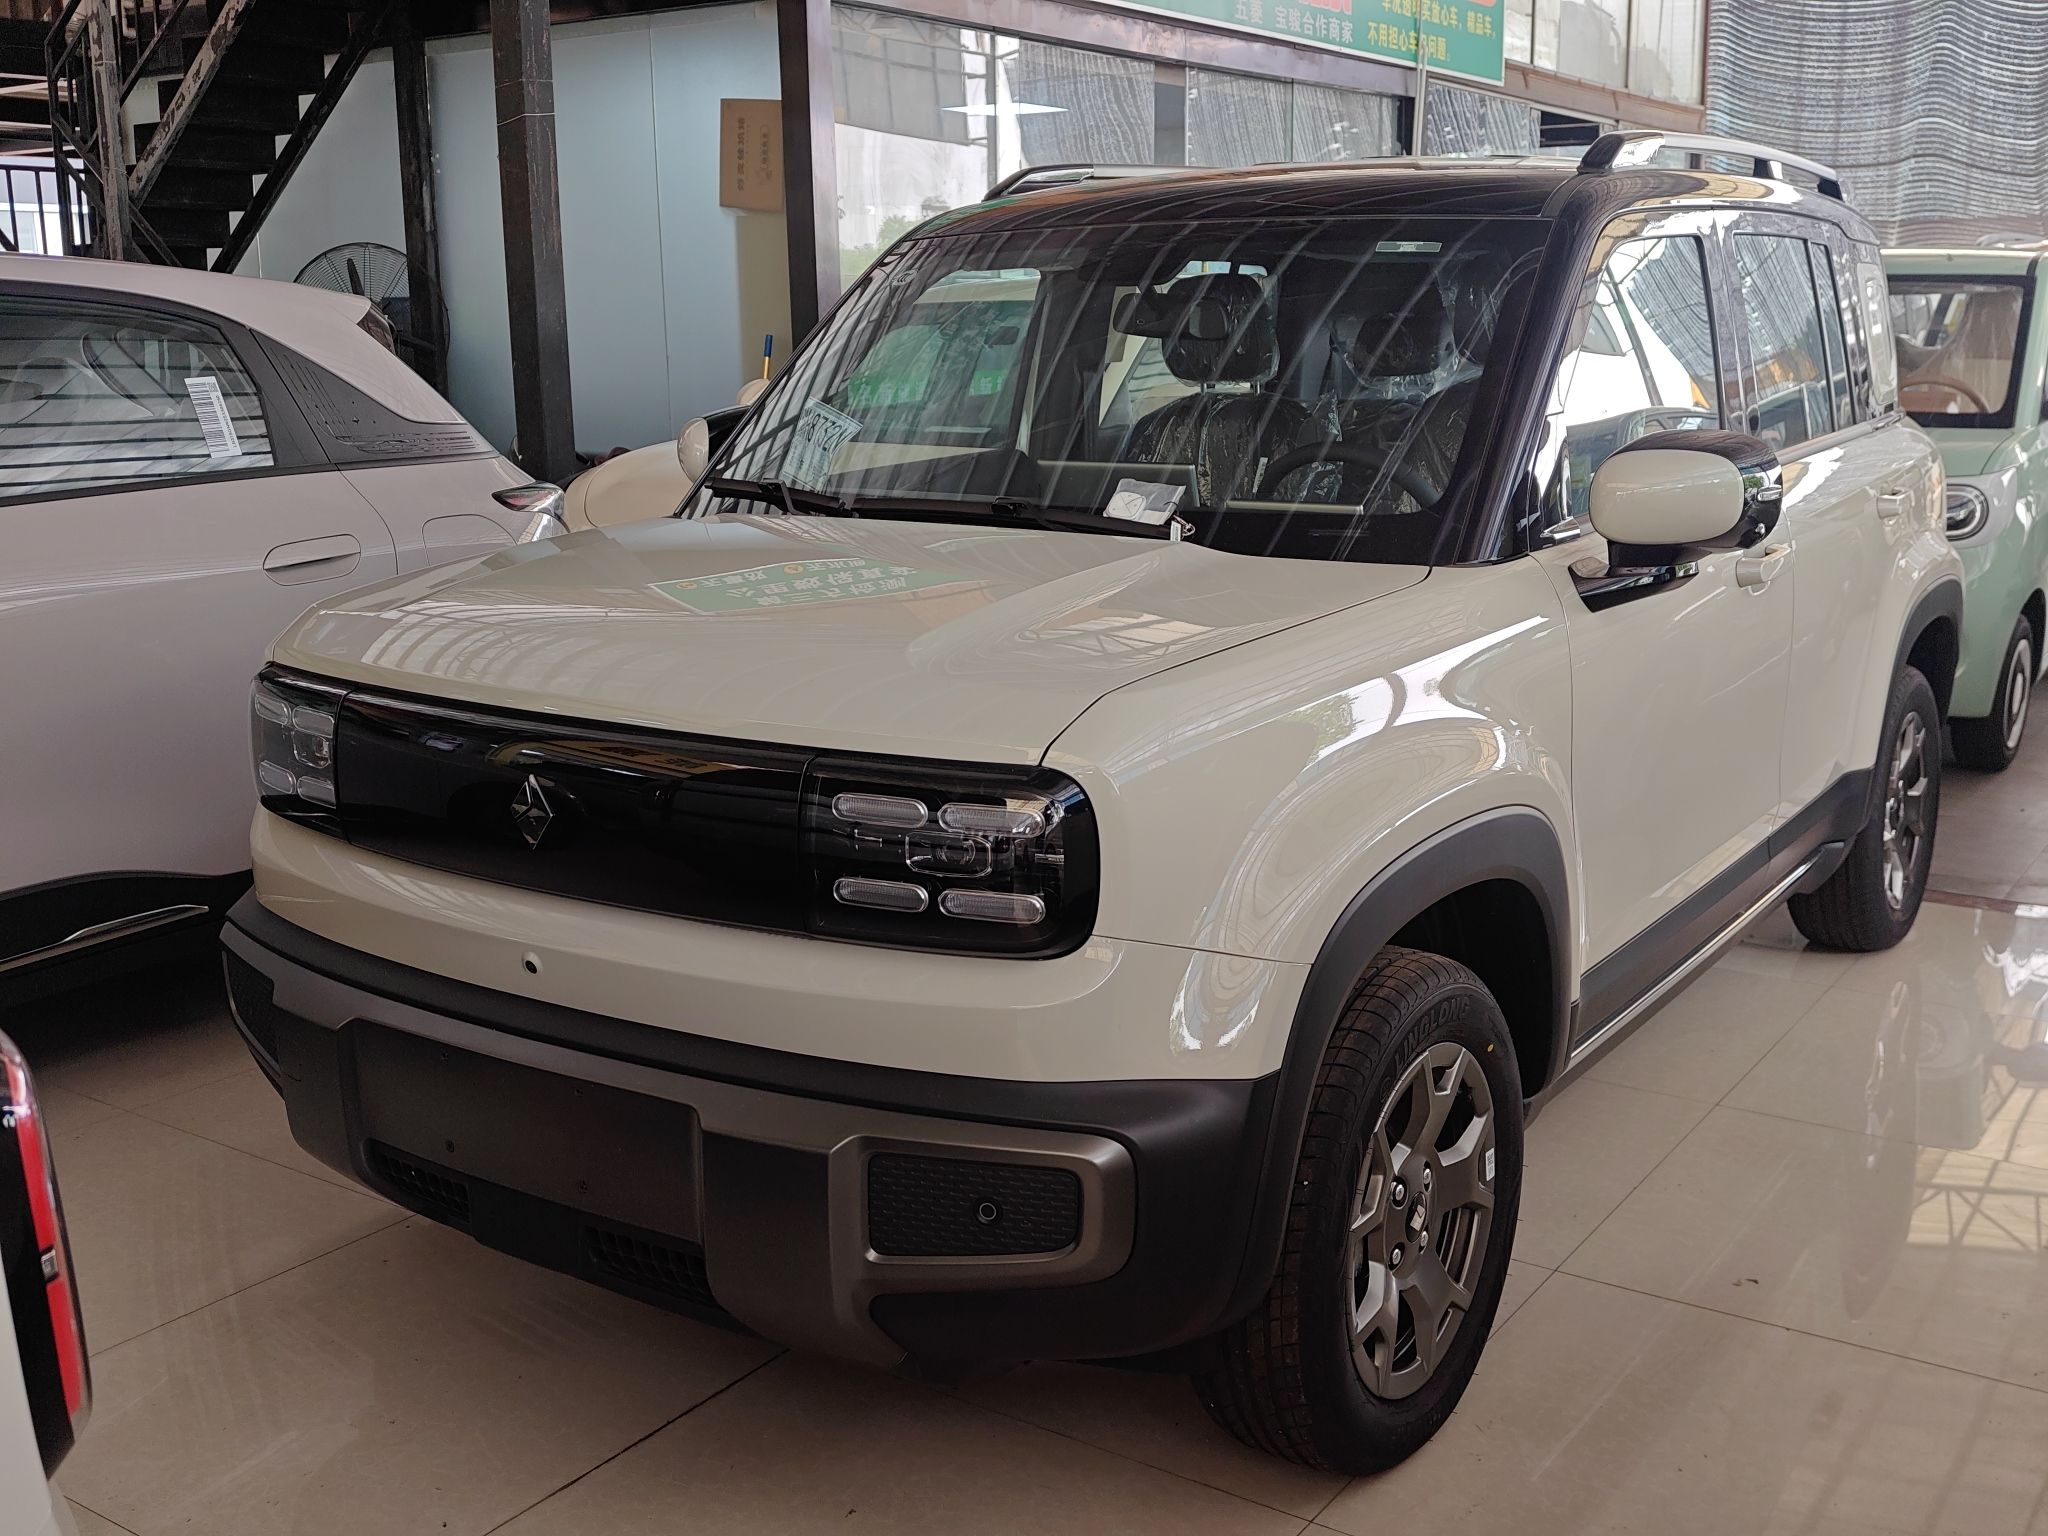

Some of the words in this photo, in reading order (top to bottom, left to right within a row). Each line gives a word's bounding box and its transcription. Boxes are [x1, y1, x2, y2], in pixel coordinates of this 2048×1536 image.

[1235, 0, 1263, 24] 五菱
[1274, 5, 1353, 44] 宝骏合作商家
[1394, 997, 1471, 1068] LINGLONG
